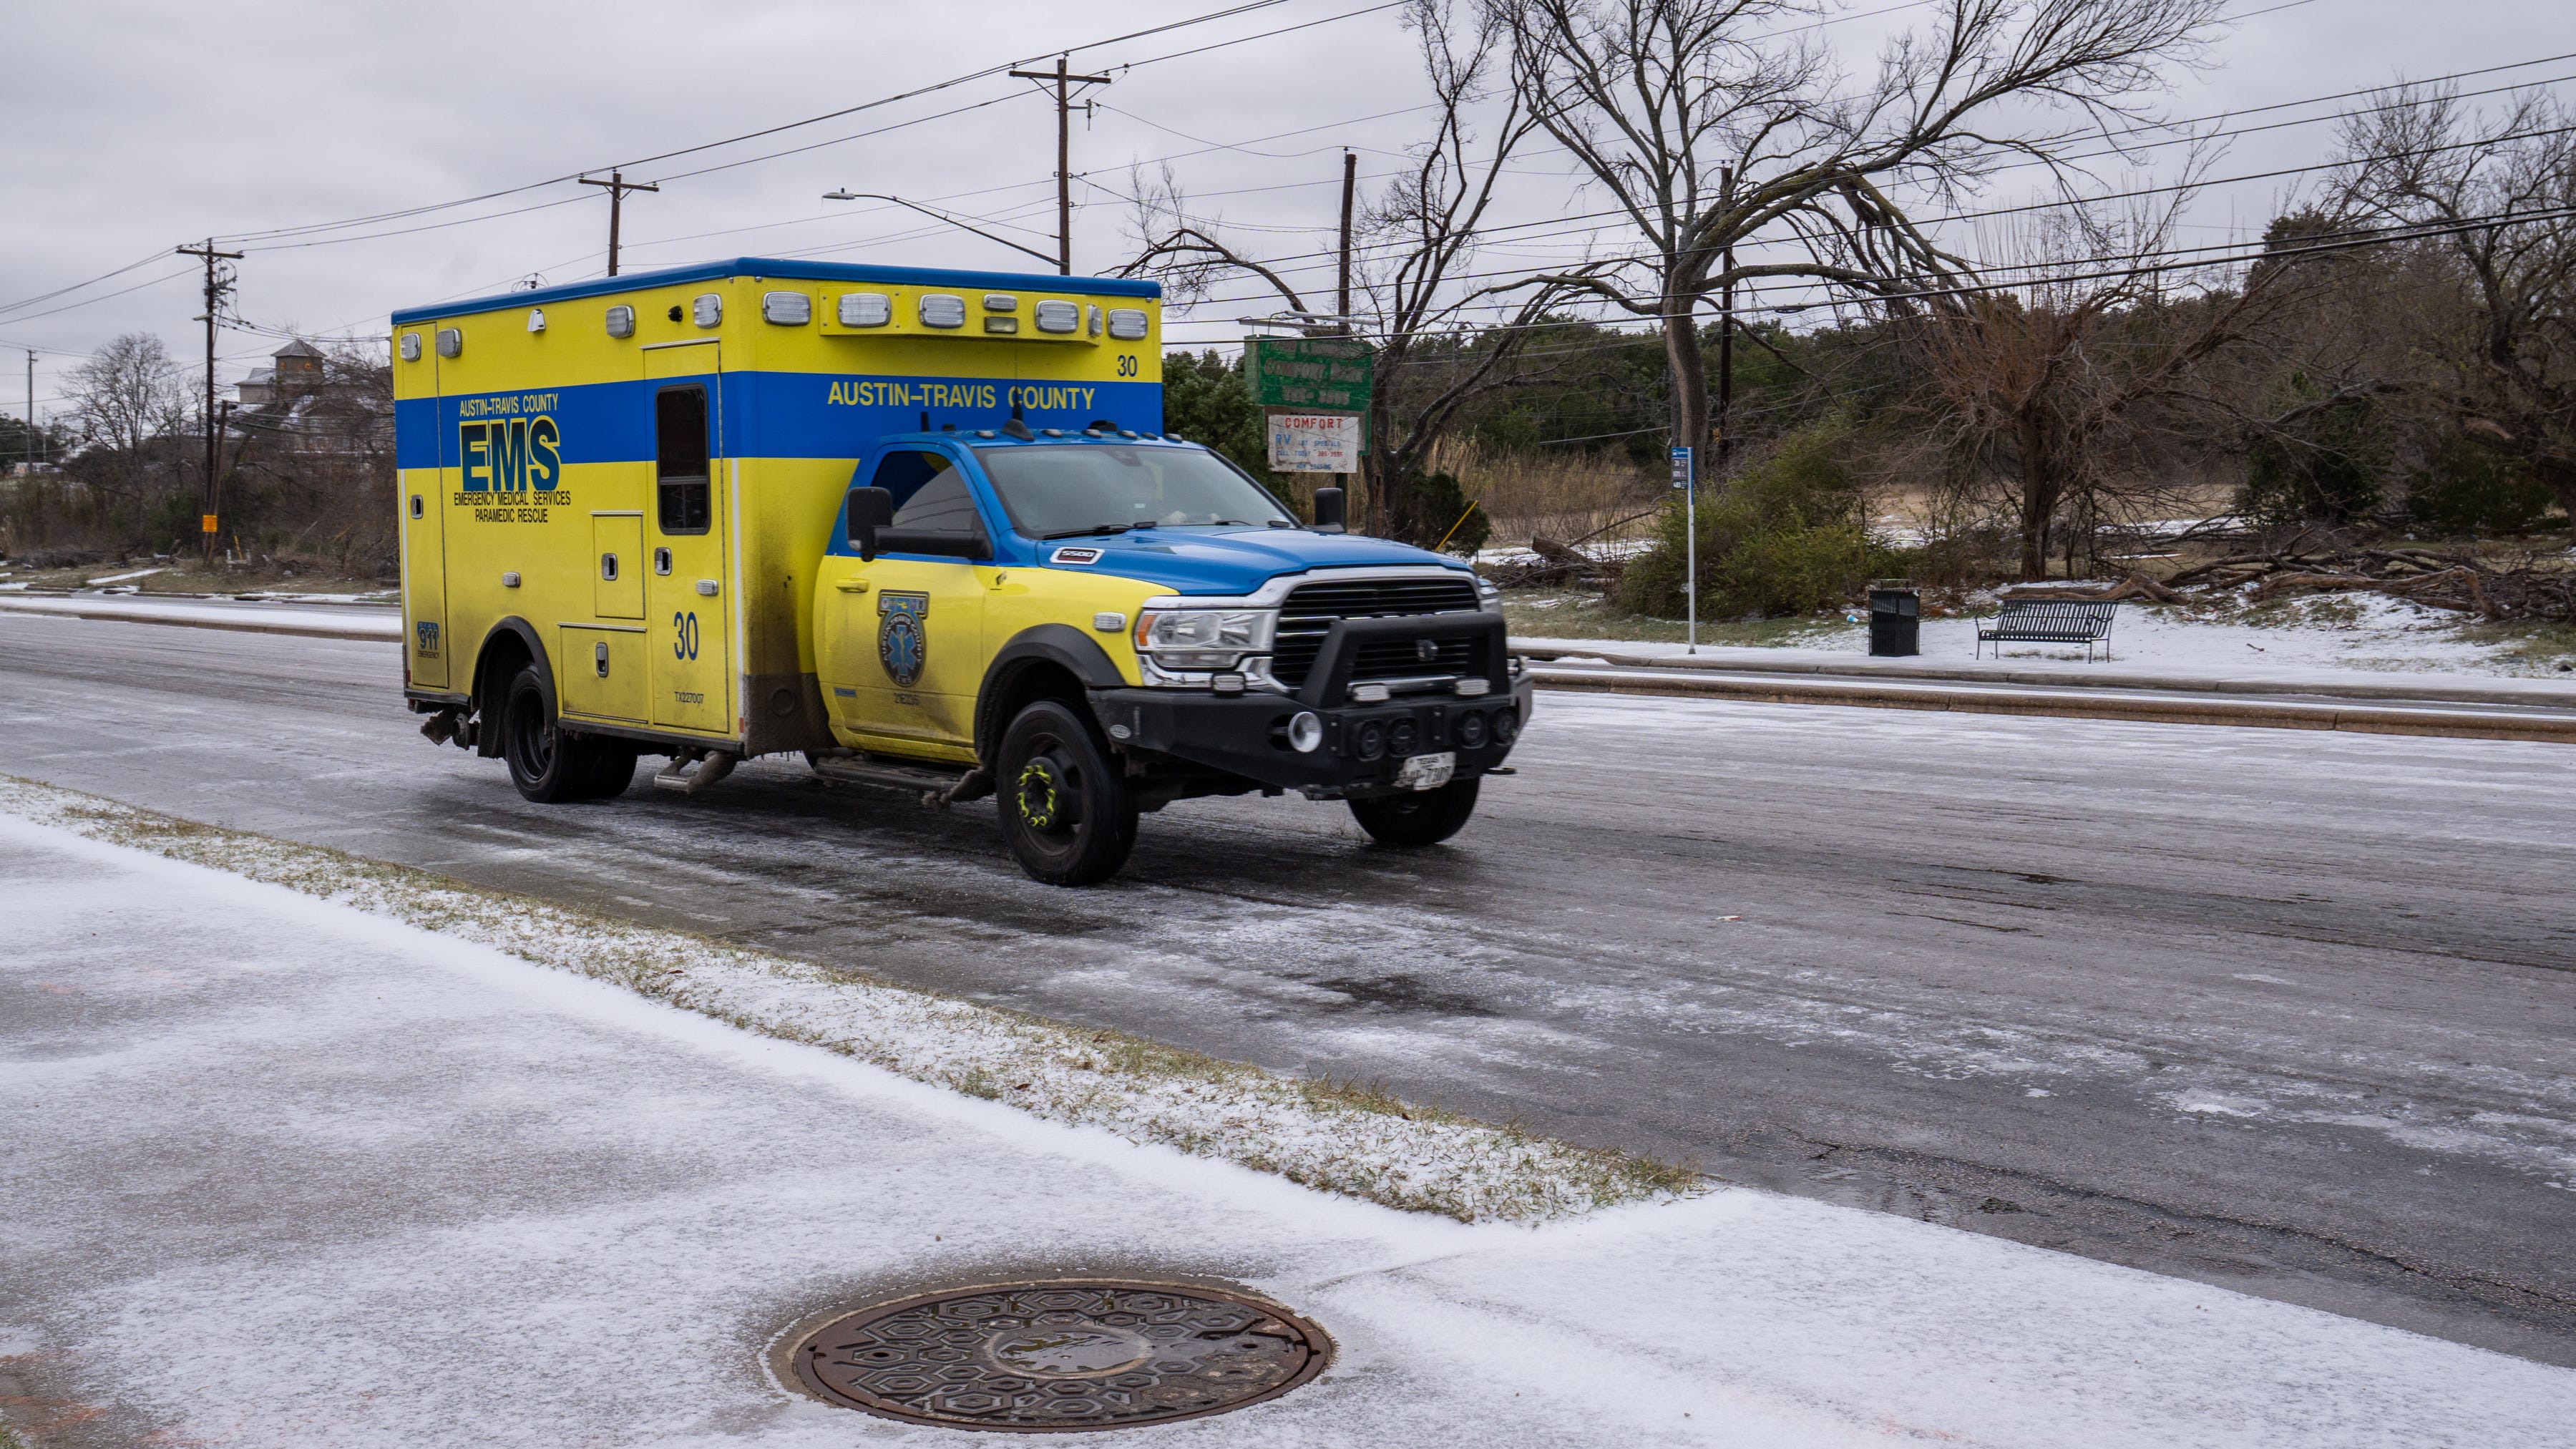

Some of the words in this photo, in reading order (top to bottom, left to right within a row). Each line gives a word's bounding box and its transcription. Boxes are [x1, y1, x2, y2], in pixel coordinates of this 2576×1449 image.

[1117, 355, 1137, 378] 30
[459, 396, 519, 416] AUSTIN-TRAVIS
[522, 393, 558, 413] COUNTY
[828, 381, 995, 409] AUSTIN-TRAVIS
[1008, 385, 1096, 410] COUNTY
[1285, 417, 1343, 429] COMFORT
[1276, 434, 1291, 445] RV
[459, 415, 560, 492] EMS
[454, 491, 494, 506] EMERGENCY
[497, 491, 529, 506] MEDICAL
[533, 491, 571, 506] SERVICES
[475, 509, 515, 522] PARAMEDIC
[517, 508, 548, 523] RESCUE
[420, 628, 437, 650] 911
[674, 611, 698, 661] 30
